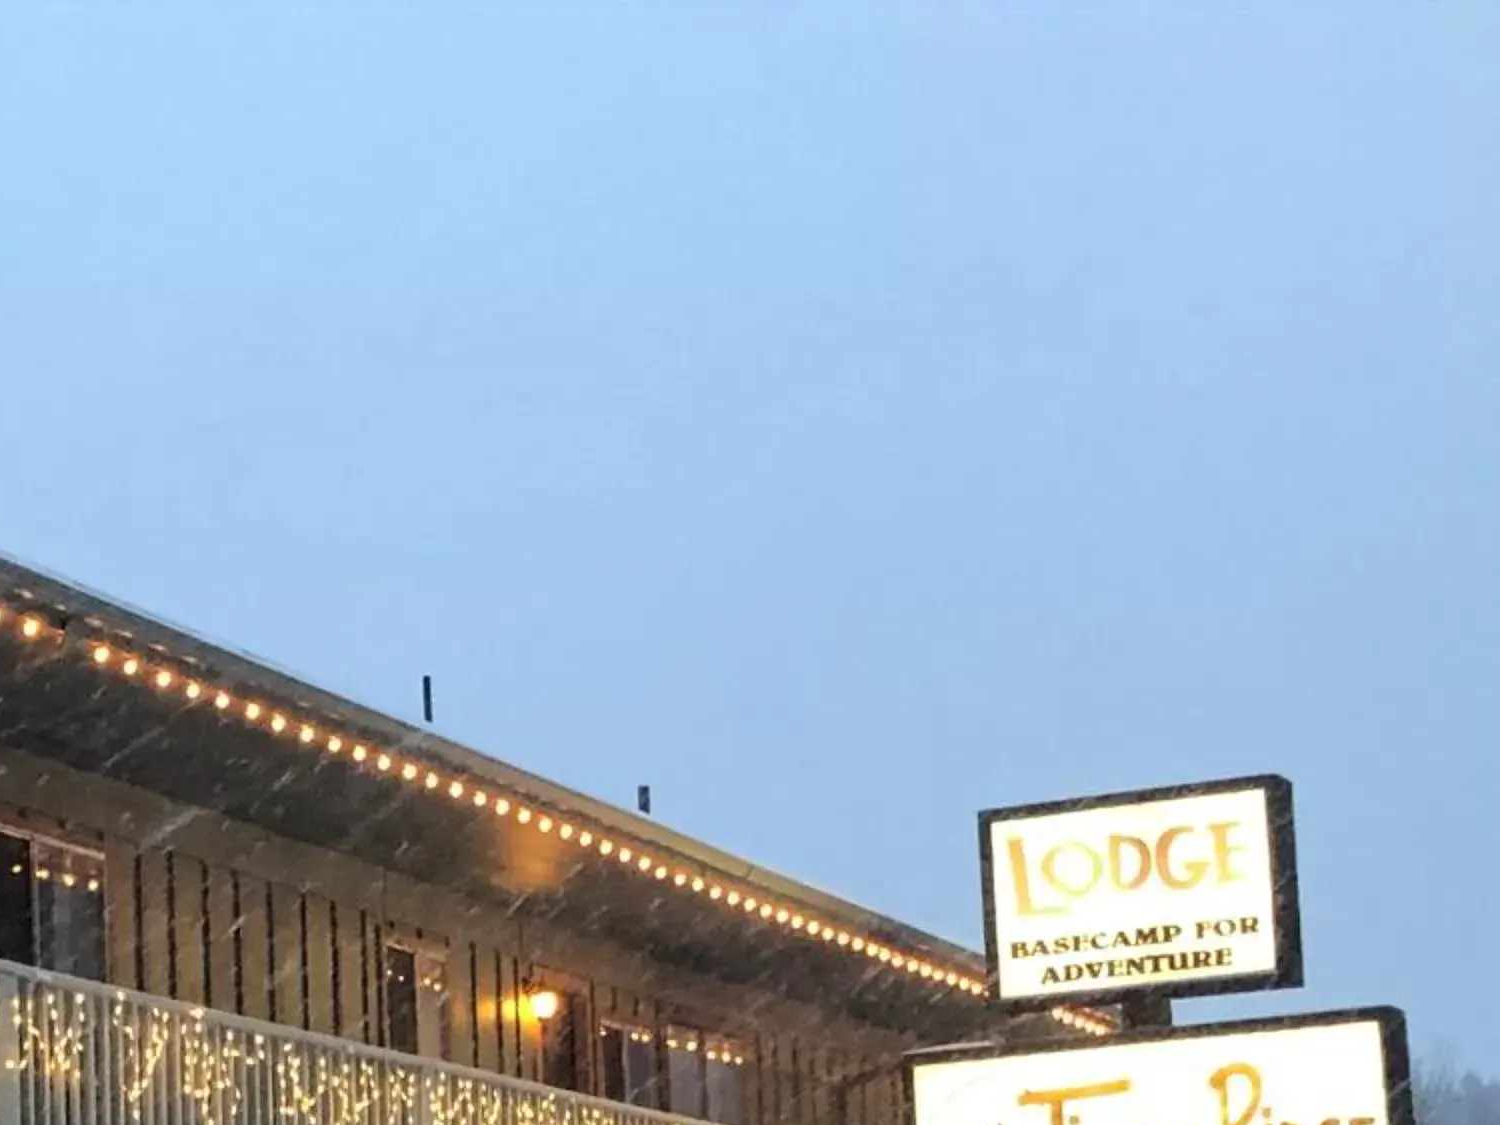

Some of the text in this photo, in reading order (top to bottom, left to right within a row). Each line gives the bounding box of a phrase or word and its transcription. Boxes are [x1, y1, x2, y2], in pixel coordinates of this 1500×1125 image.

[1008, 821, 1246, 915] LODGE
[1010, 916, 1260, 959] BASECAMP FOR
[1041, 948, 1233, 985] ADVENTURE
